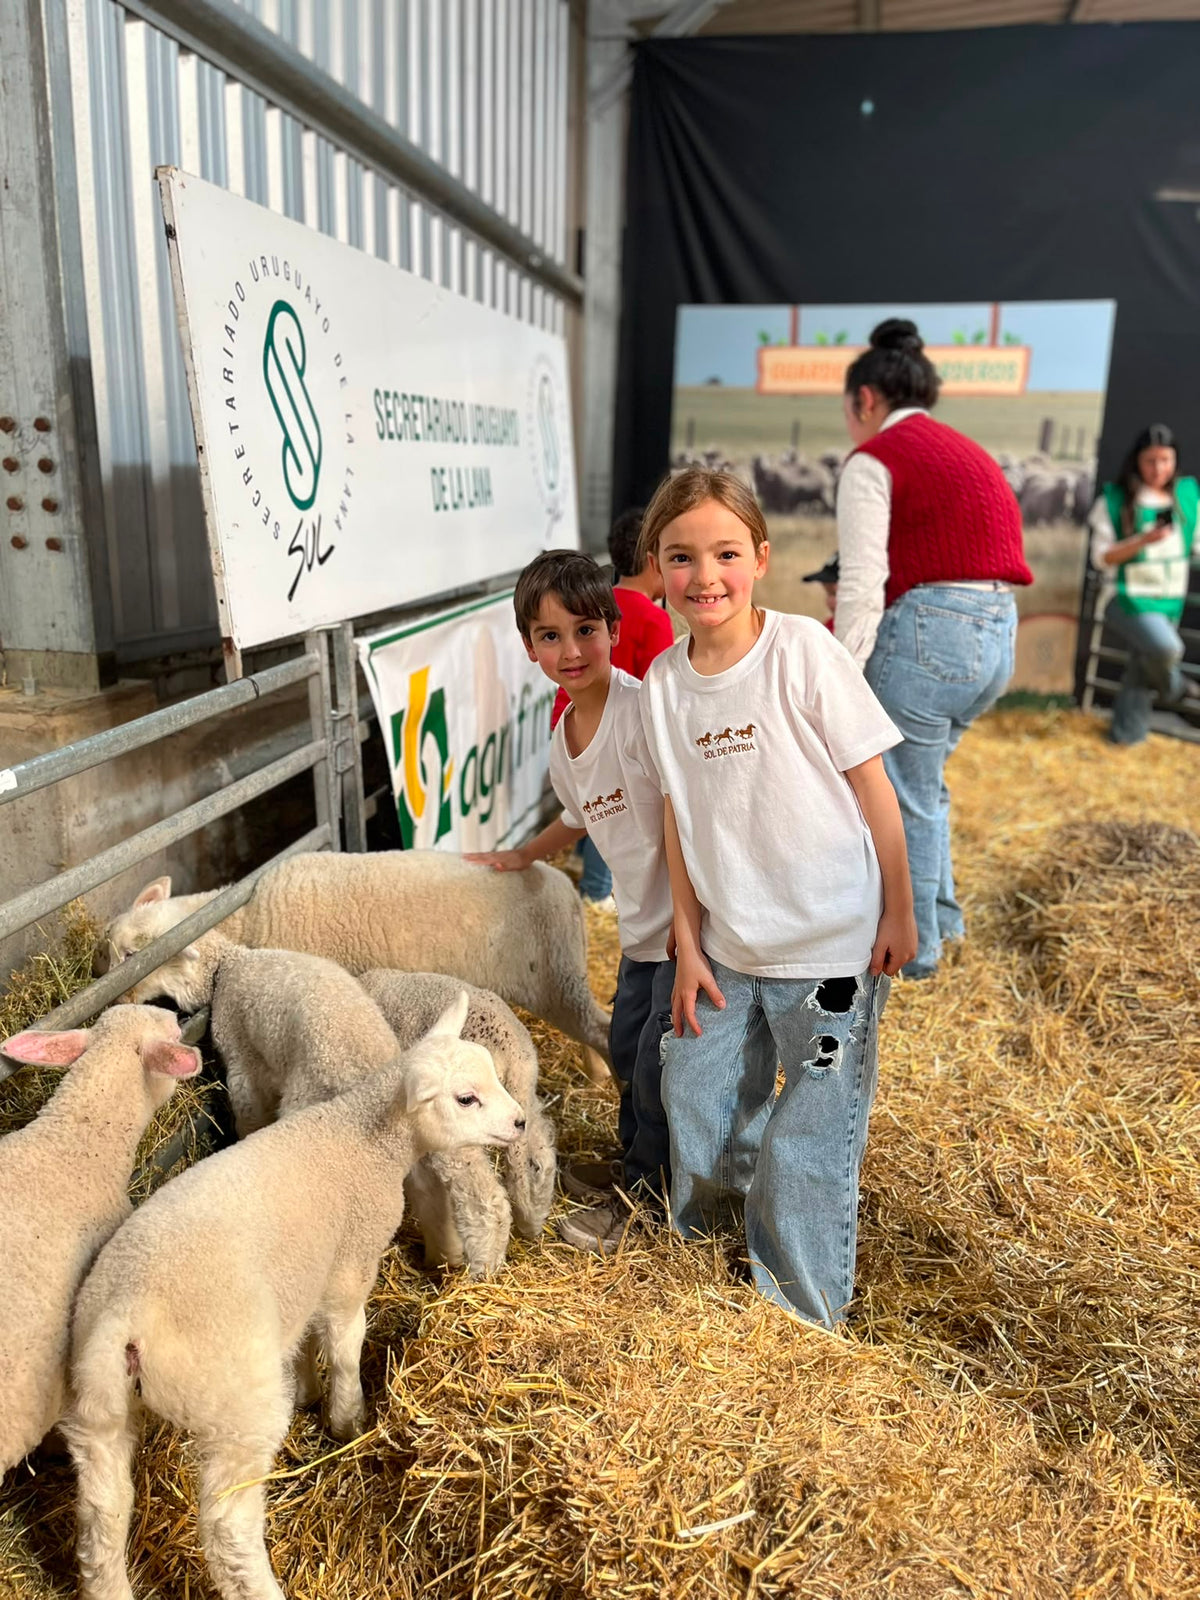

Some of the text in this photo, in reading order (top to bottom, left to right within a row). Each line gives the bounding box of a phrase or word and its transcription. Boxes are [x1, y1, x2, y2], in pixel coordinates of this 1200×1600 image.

[223, 255, 354, 540] SECRETARIADO URUGUAYO DE LA LANA
[374, 388, 467, 442] SECRETARIADO
[430, 467, 449, 512] DE
[449, 467, 466, 509] LA
[287, 513, 335, 602] SUL
[704, 742, 756, 760] SOL DE PATRIA
[597, 811, 605, 820] DE
[604, 803, 628, 817] PATRIA
